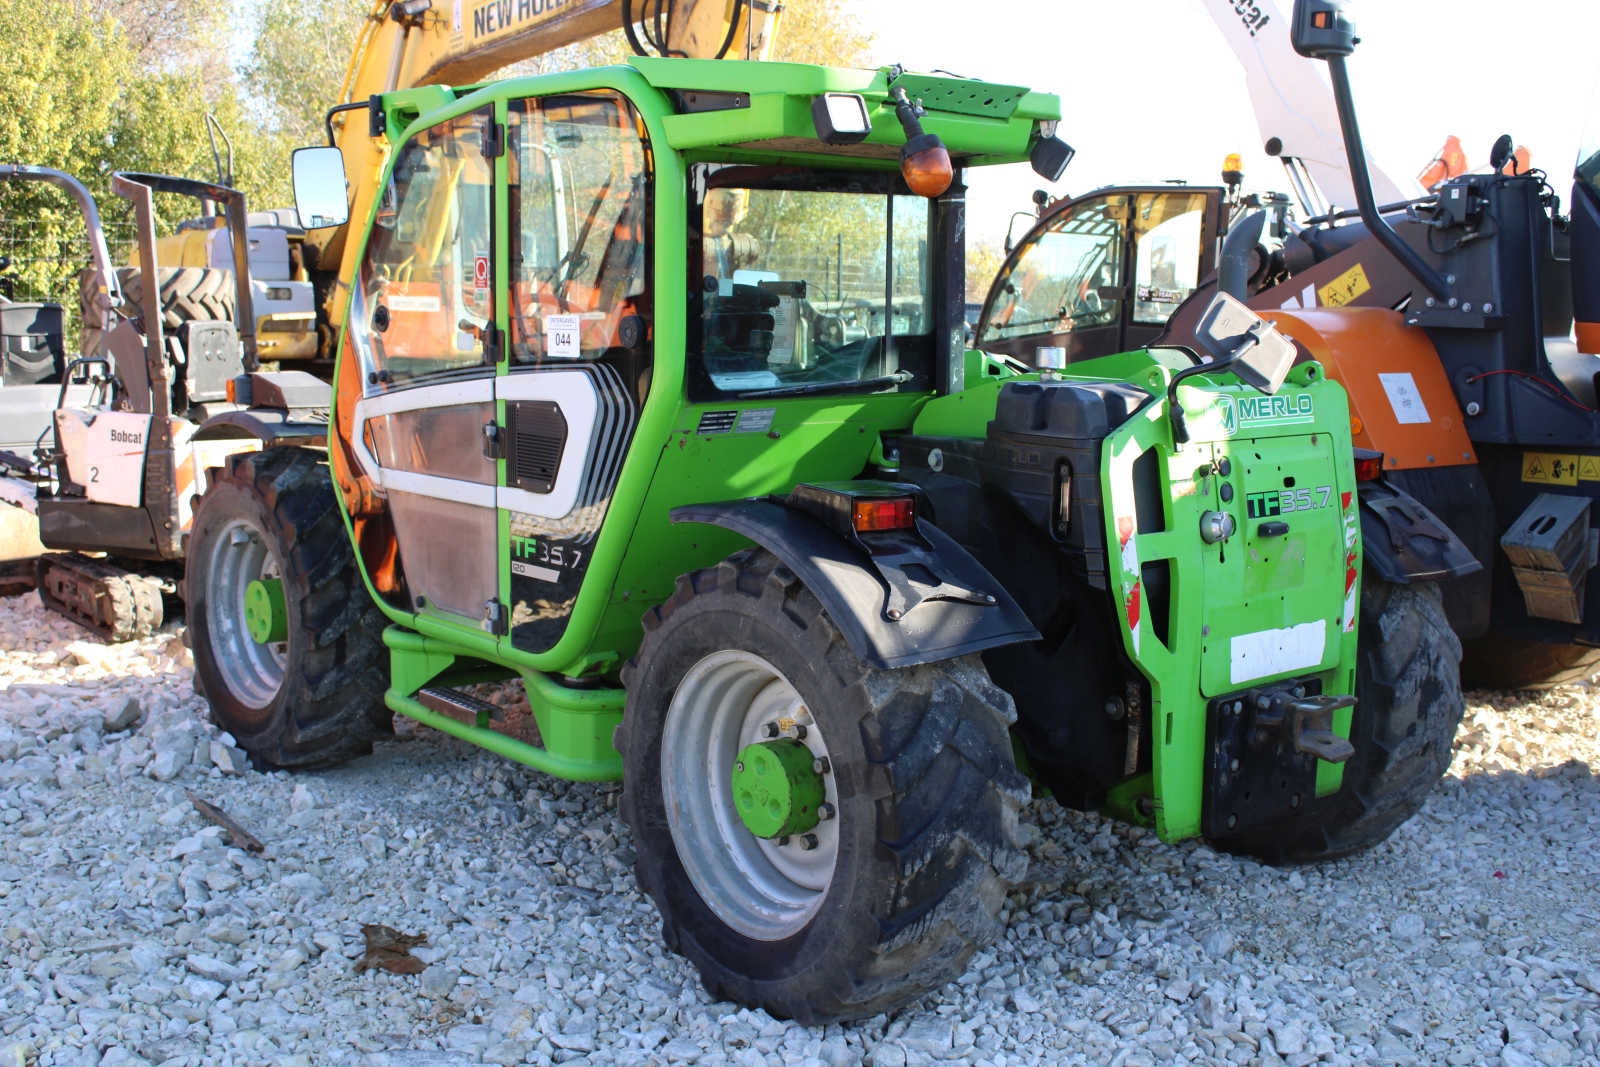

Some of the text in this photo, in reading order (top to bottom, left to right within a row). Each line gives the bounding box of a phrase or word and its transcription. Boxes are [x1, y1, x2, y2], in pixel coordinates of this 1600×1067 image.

[474, 0, 516, 38] NEW
[1229, 0, 1270, 37] cat
[555, 333, 571, 346] 044
[1238, 394, 1313, 419] MERLO
[111, 429, 142, 444] Bobcat
[90, 466, 99, 483] 2
